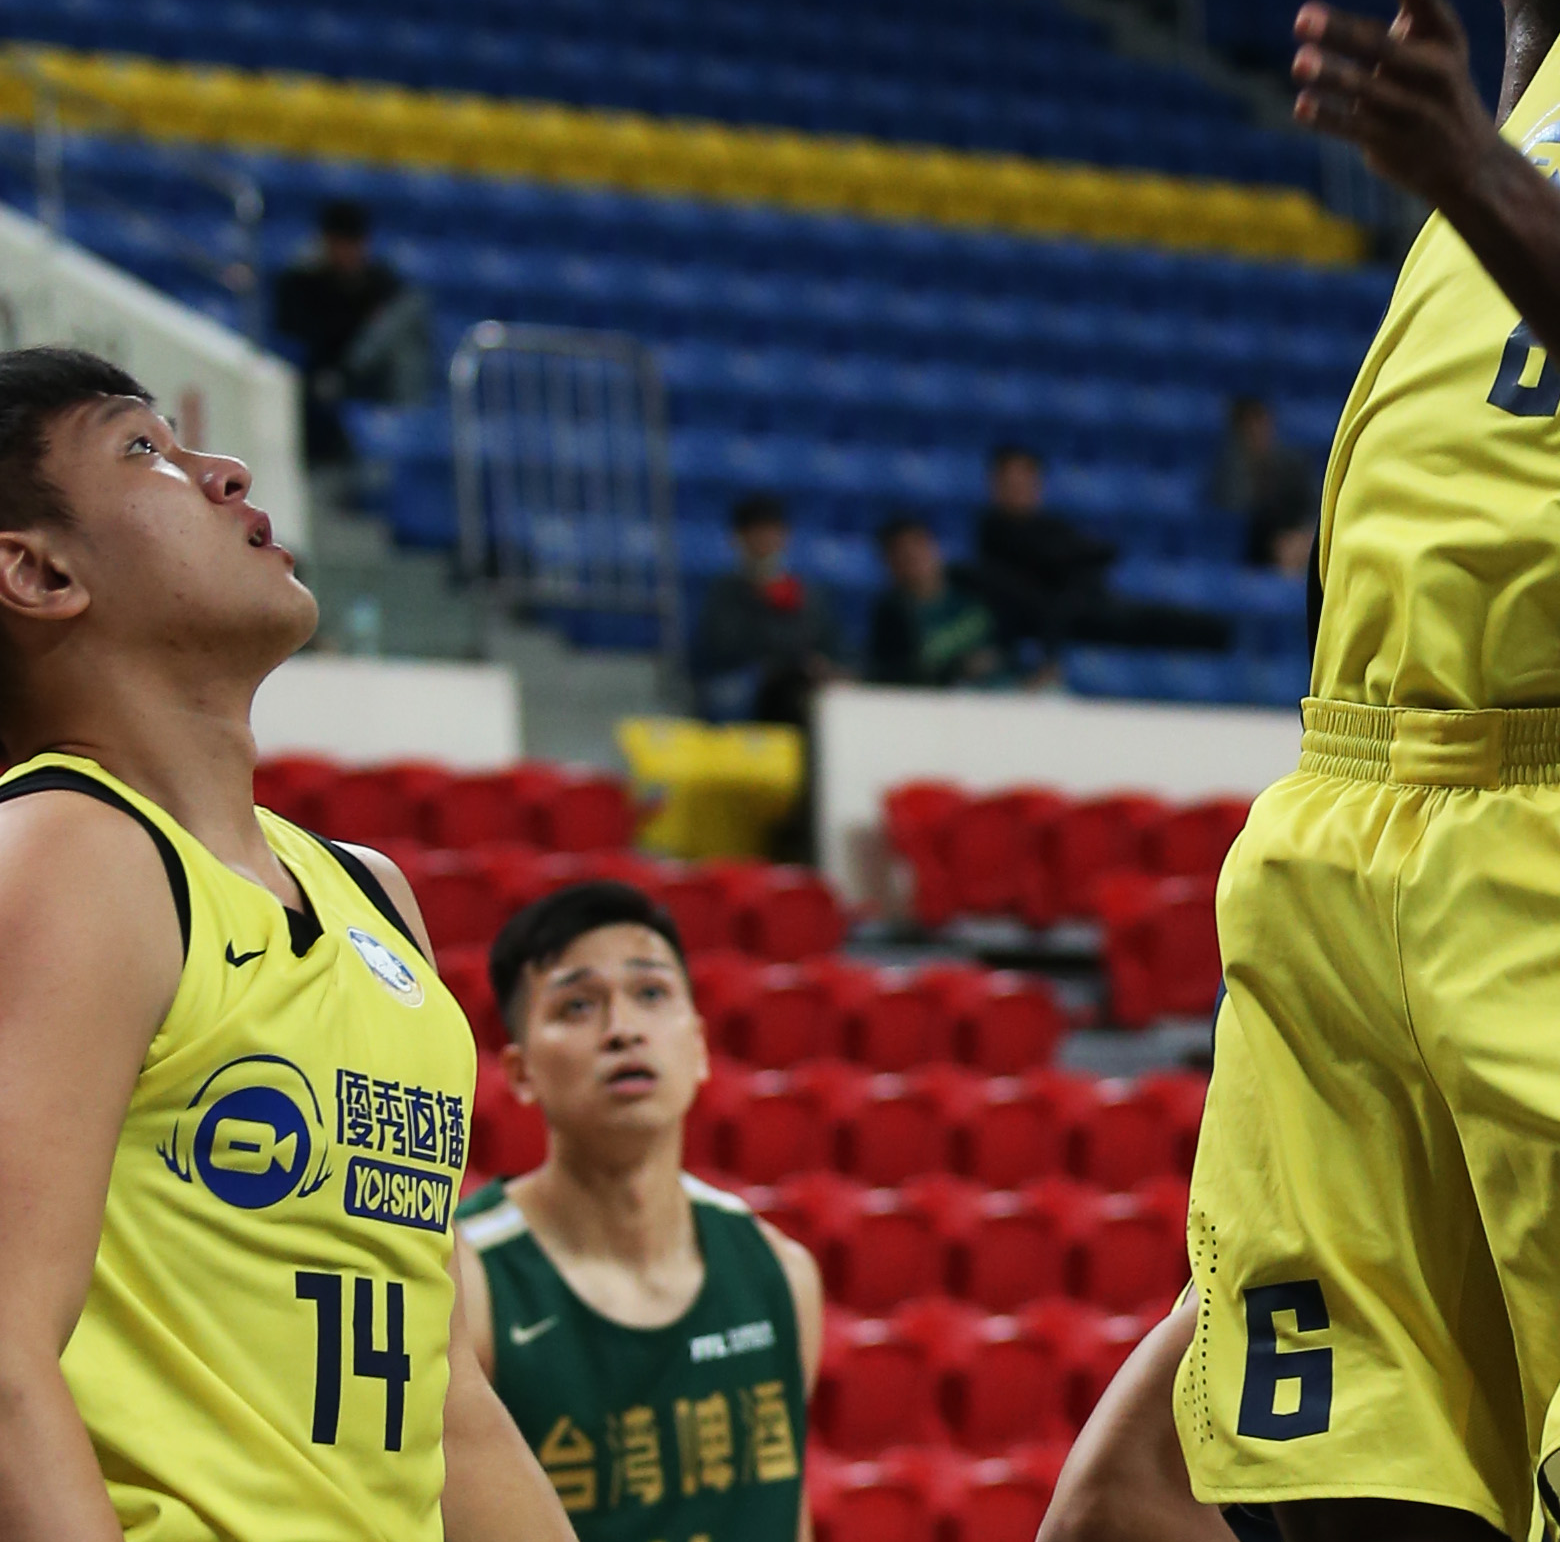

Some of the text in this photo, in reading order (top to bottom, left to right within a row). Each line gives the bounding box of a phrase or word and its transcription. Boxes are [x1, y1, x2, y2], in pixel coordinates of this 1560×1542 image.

[353, 1164, 449, 1227] YO!SHOW
[295, 1271, 411, 1452] 14
[1236, 1279, 1333, 1442] 6
